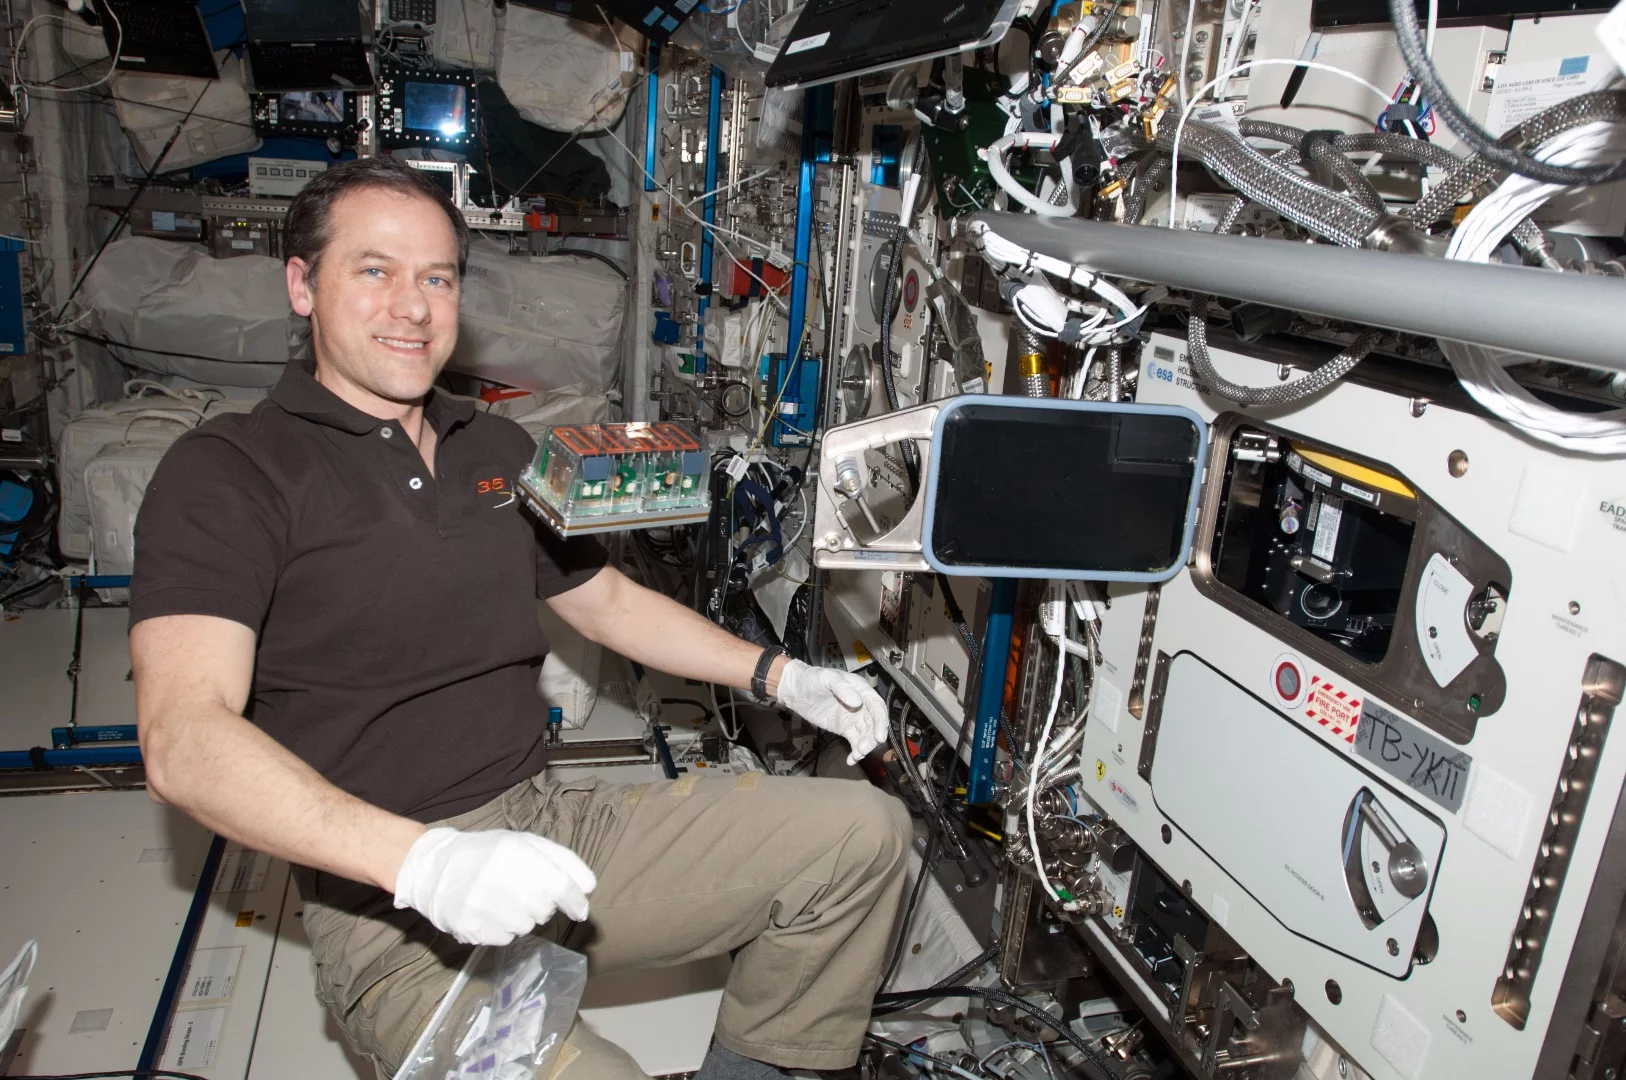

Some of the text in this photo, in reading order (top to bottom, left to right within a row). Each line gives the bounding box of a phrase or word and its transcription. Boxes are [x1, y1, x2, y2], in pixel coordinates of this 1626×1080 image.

[1179, 353, 1194, 365] EMC
[1157, 367, 1173, 382] esa
[1176, 377, 1211, 396] STRUCTURE
[476, 477, 506, 495] 35
[1599, 500, 1626, 519] EAD
[1432, 578, 1449, 595] CLOSE
[1314, 696, 1350, 723] FIRE PORT
